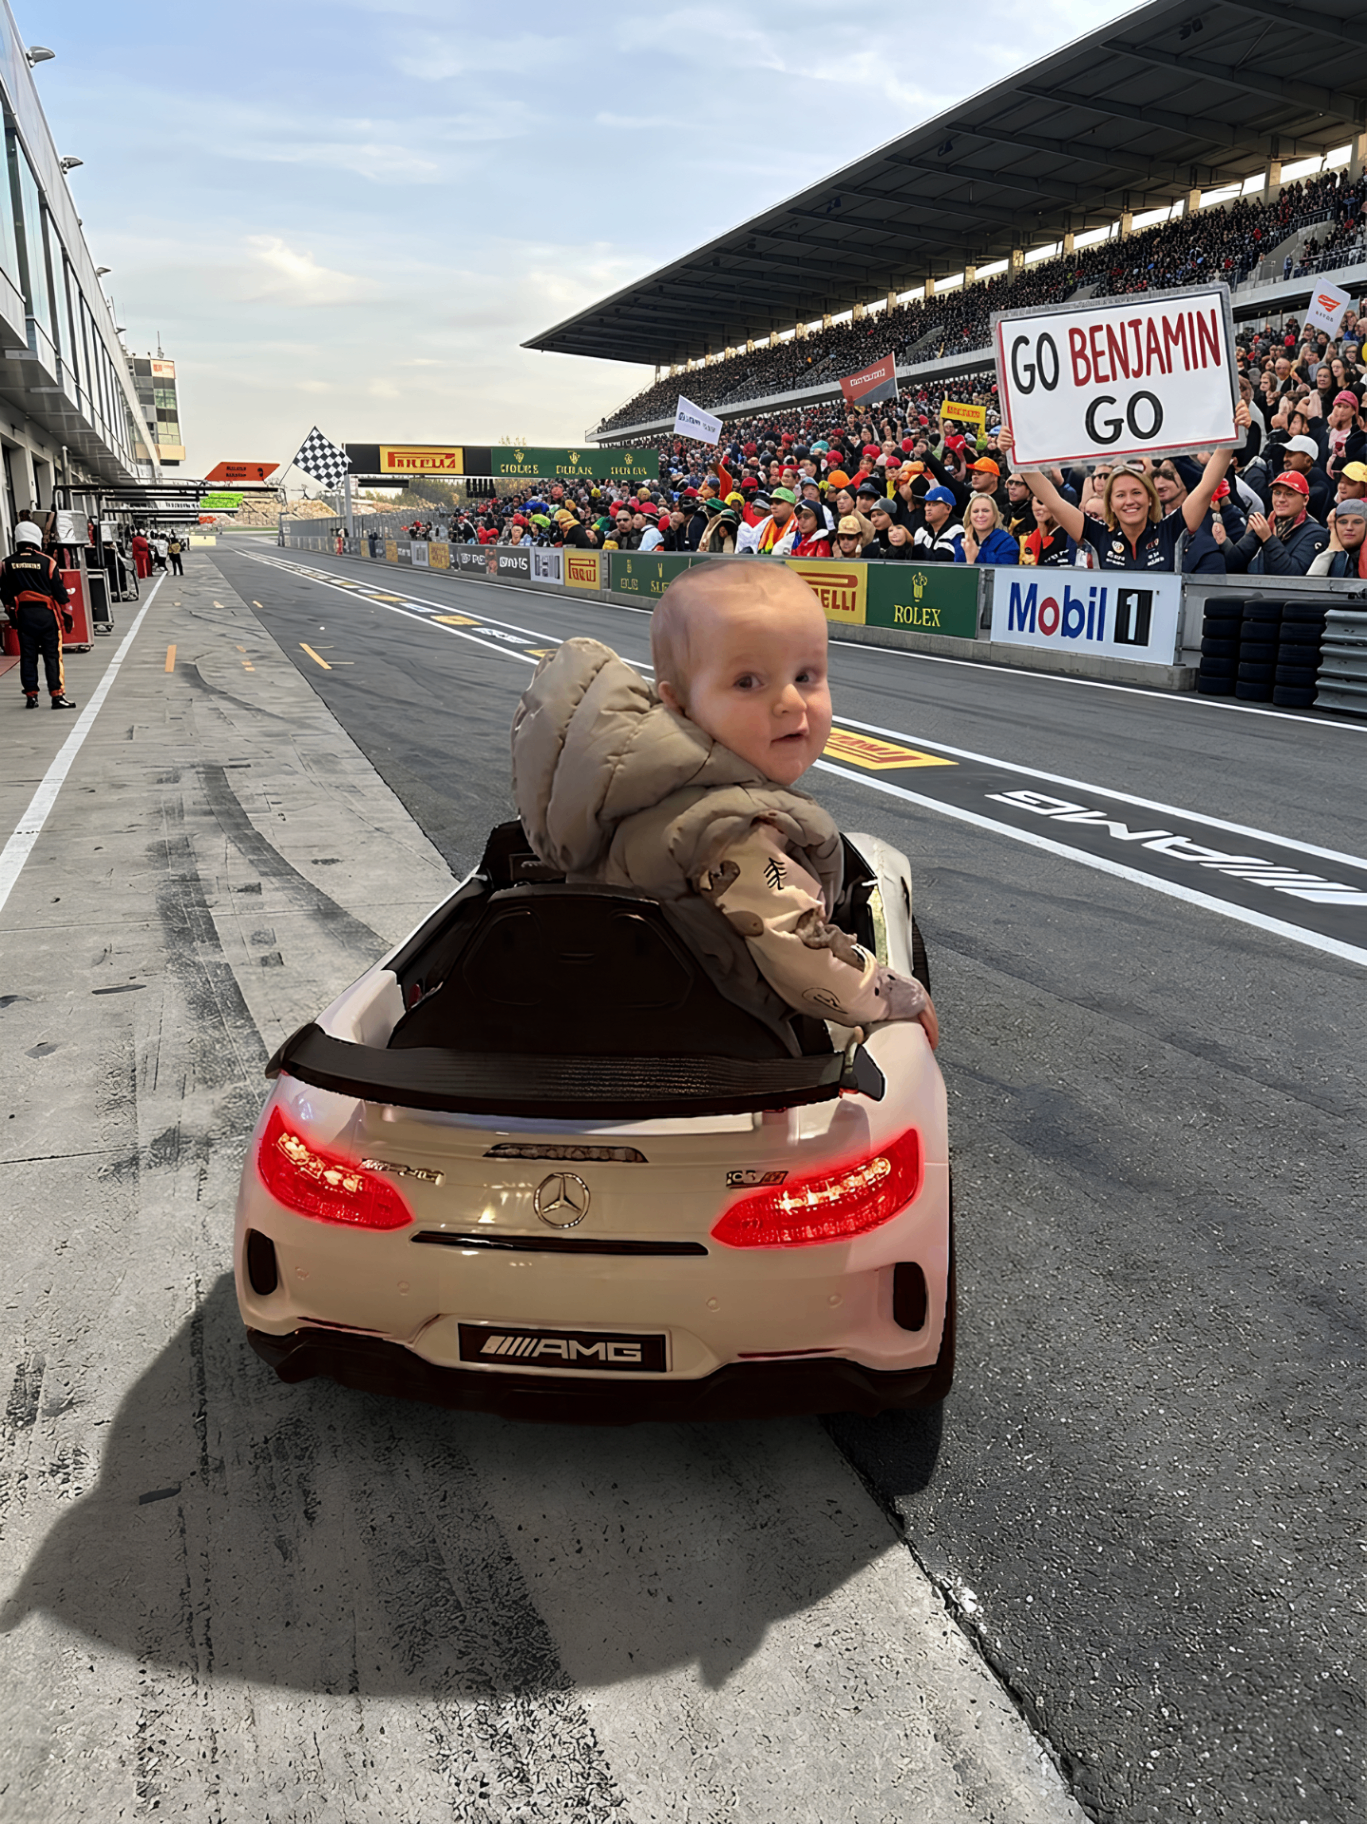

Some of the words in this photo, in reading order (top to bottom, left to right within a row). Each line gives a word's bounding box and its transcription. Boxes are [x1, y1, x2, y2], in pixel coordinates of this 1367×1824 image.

[1011, 332, 1059, 394] GO
[1069, 309, 1221, 387] BENJAMIN
[1085, 390, 1163, 445] GO
[893, 604, 941, 628] ROLEX
[1008, 582, 1107, 642] Mobil
[1126, 593, 1139, 641] 1
[531, 1337, 642, 1364] AMG
